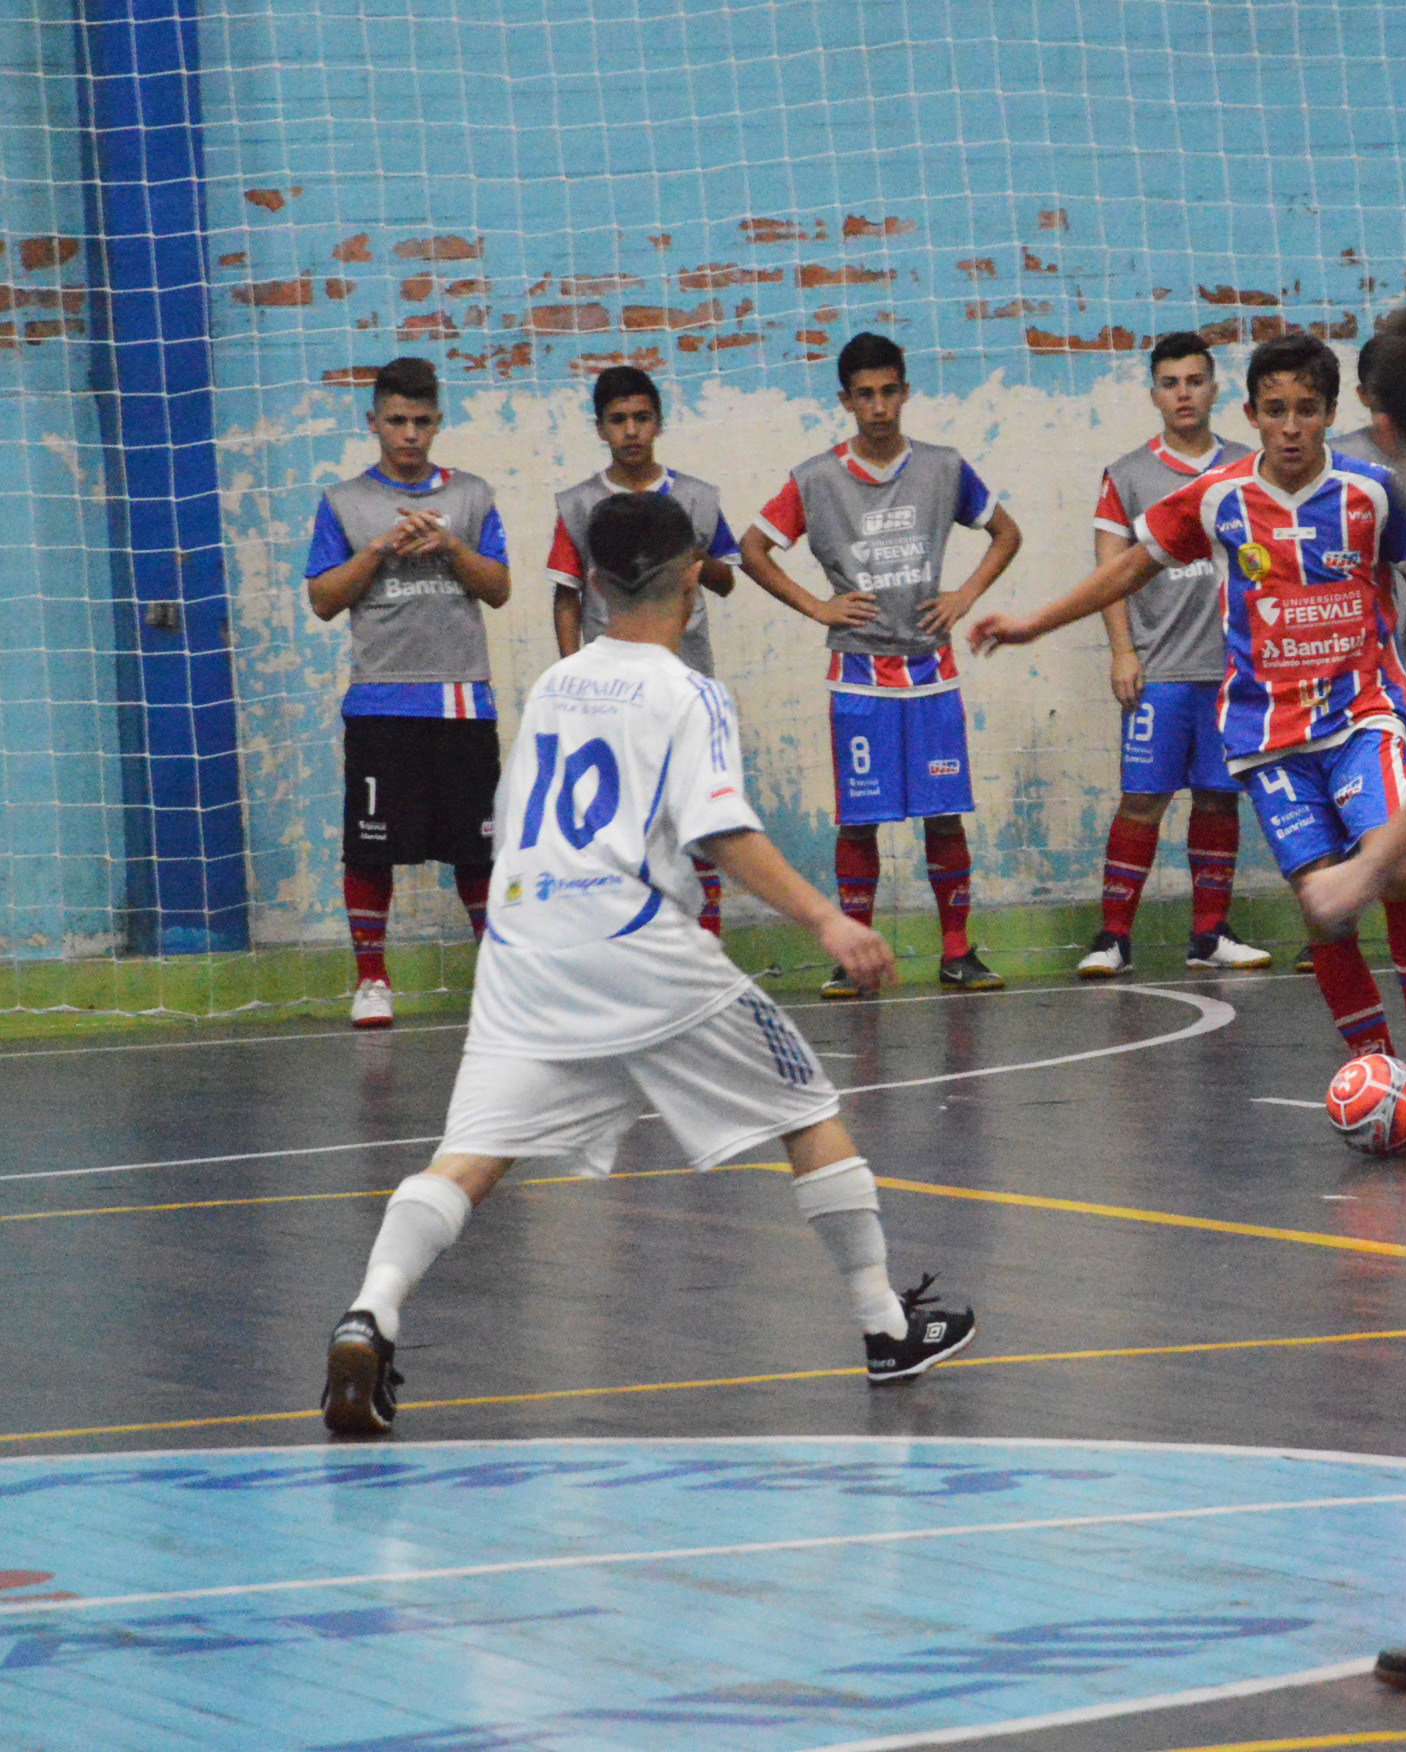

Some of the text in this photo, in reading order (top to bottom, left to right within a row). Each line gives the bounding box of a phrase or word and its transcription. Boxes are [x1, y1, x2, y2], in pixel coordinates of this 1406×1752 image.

[857, 560, 931, 592] Banrisl
[1283, 590, 1361, 608] UNIVERSIDADE
[1284, 598, 1363, 625] FEEVALE
[1282, 627, 1367, 658] Banrisul
[1299, 677, 1332, 716] 4
[1128, 702, 1154, 741] 13
[851, 736, 870, 775] 8
[365, 776, 377, 816] 1
[518, 733, 620, 850] 10
[1257, 766, 1297, 802] 4
